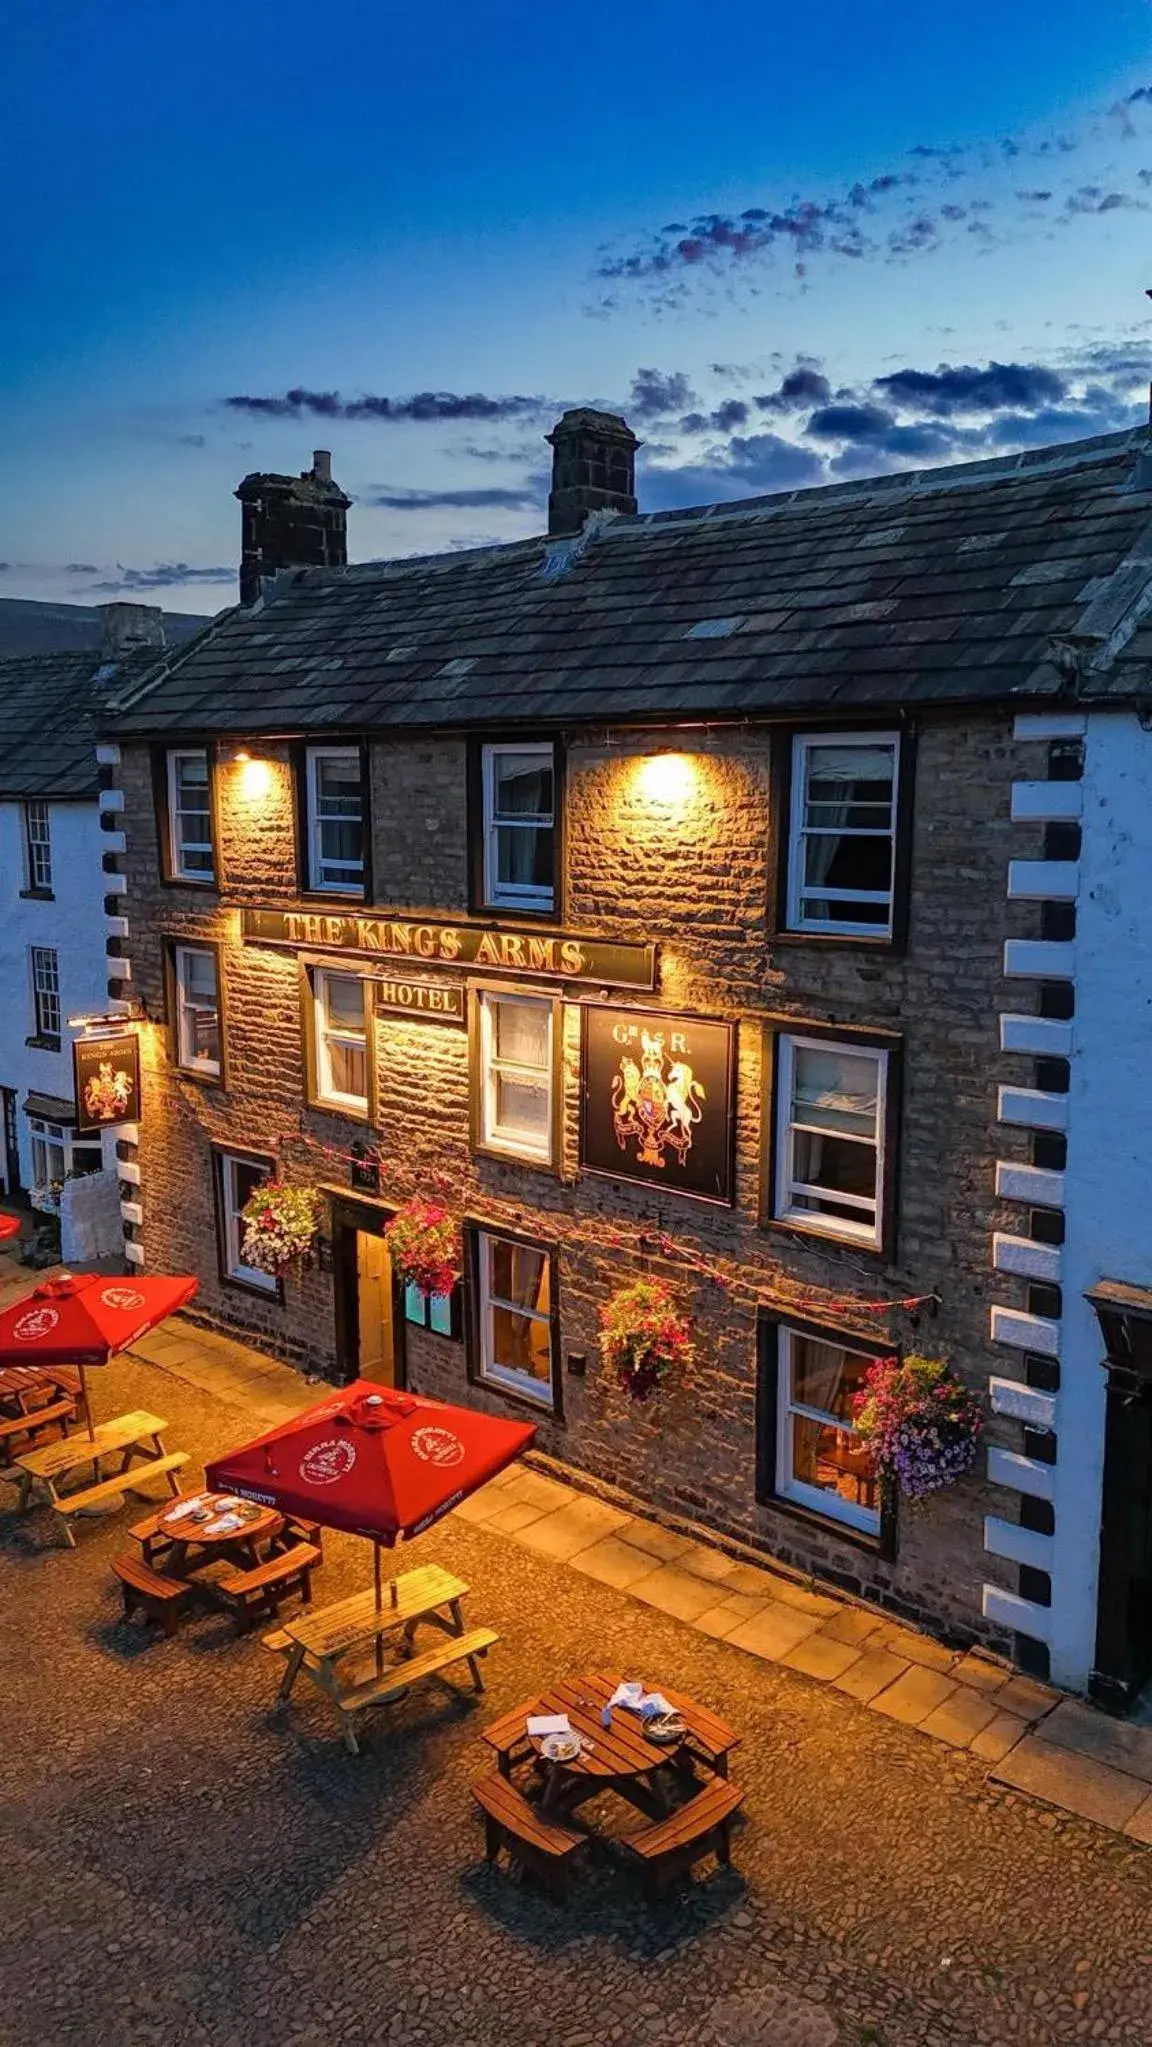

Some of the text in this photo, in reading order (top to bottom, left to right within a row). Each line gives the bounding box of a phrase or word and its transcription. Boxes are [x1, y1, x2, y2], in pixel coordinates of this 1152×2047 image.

[283, 914, 586, 975] THE KINGS ARMS
[383, 982, 457, 1012] HOTEL
